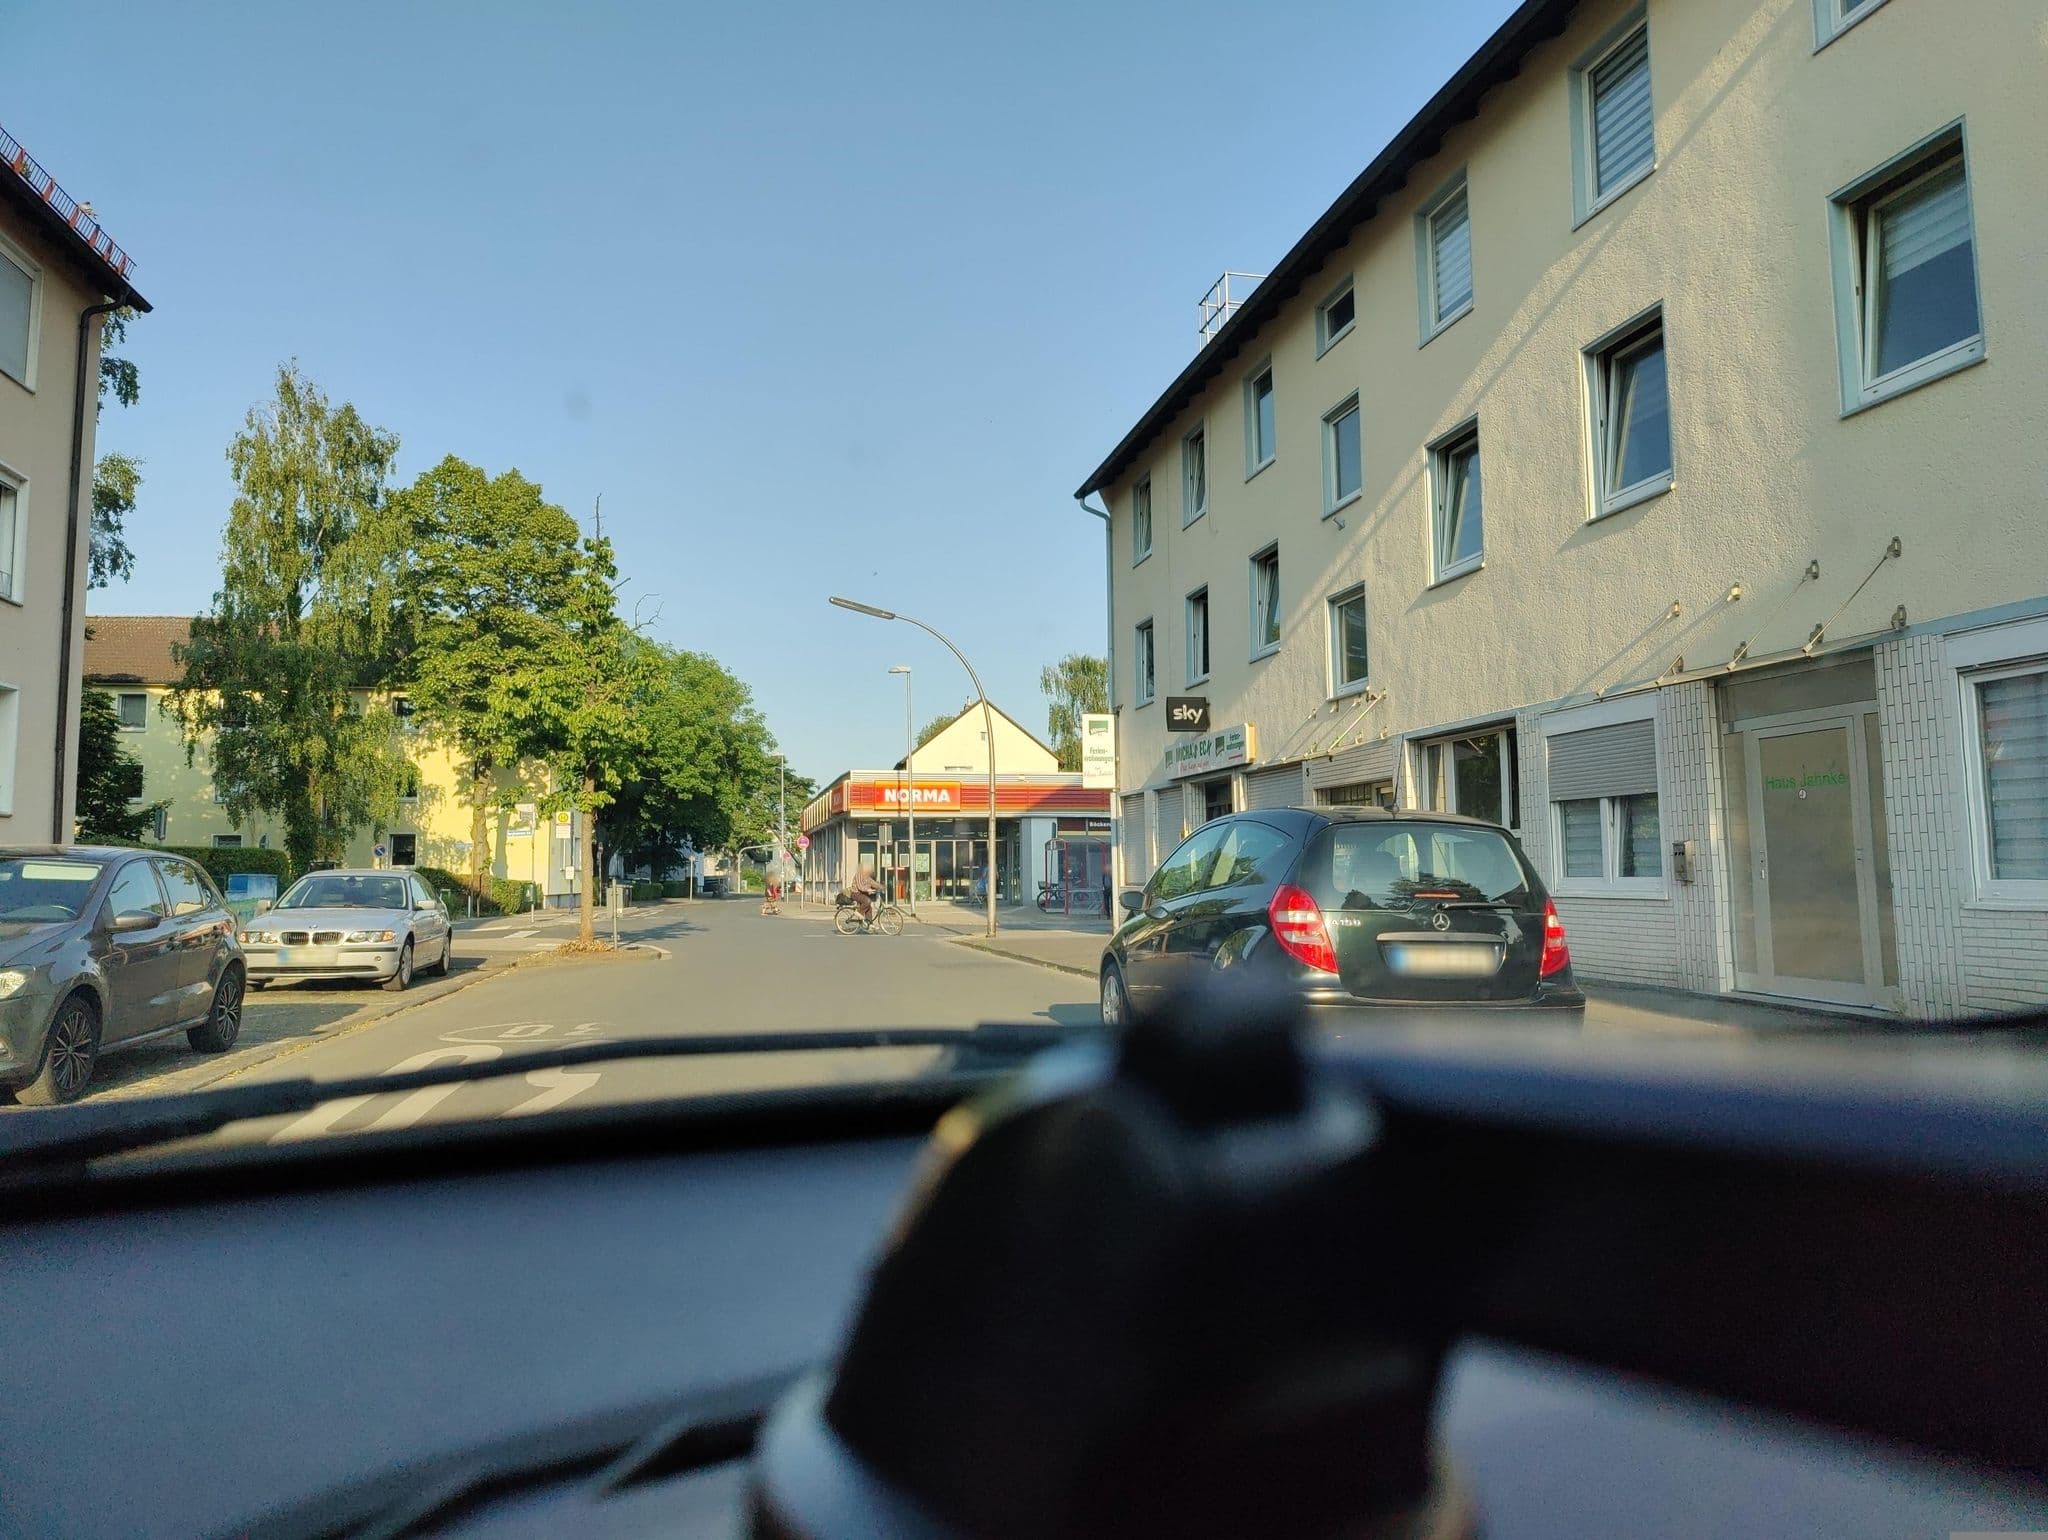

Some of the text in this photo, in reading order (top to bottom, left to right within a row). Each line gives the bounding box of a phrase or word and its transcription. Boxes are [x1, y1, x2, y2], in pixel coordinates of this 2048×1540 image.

[1173, 704, 1203, 724] sky
[1765, 776, 1796, 790] Haus
[884, 788, 951, 803] NORMA
